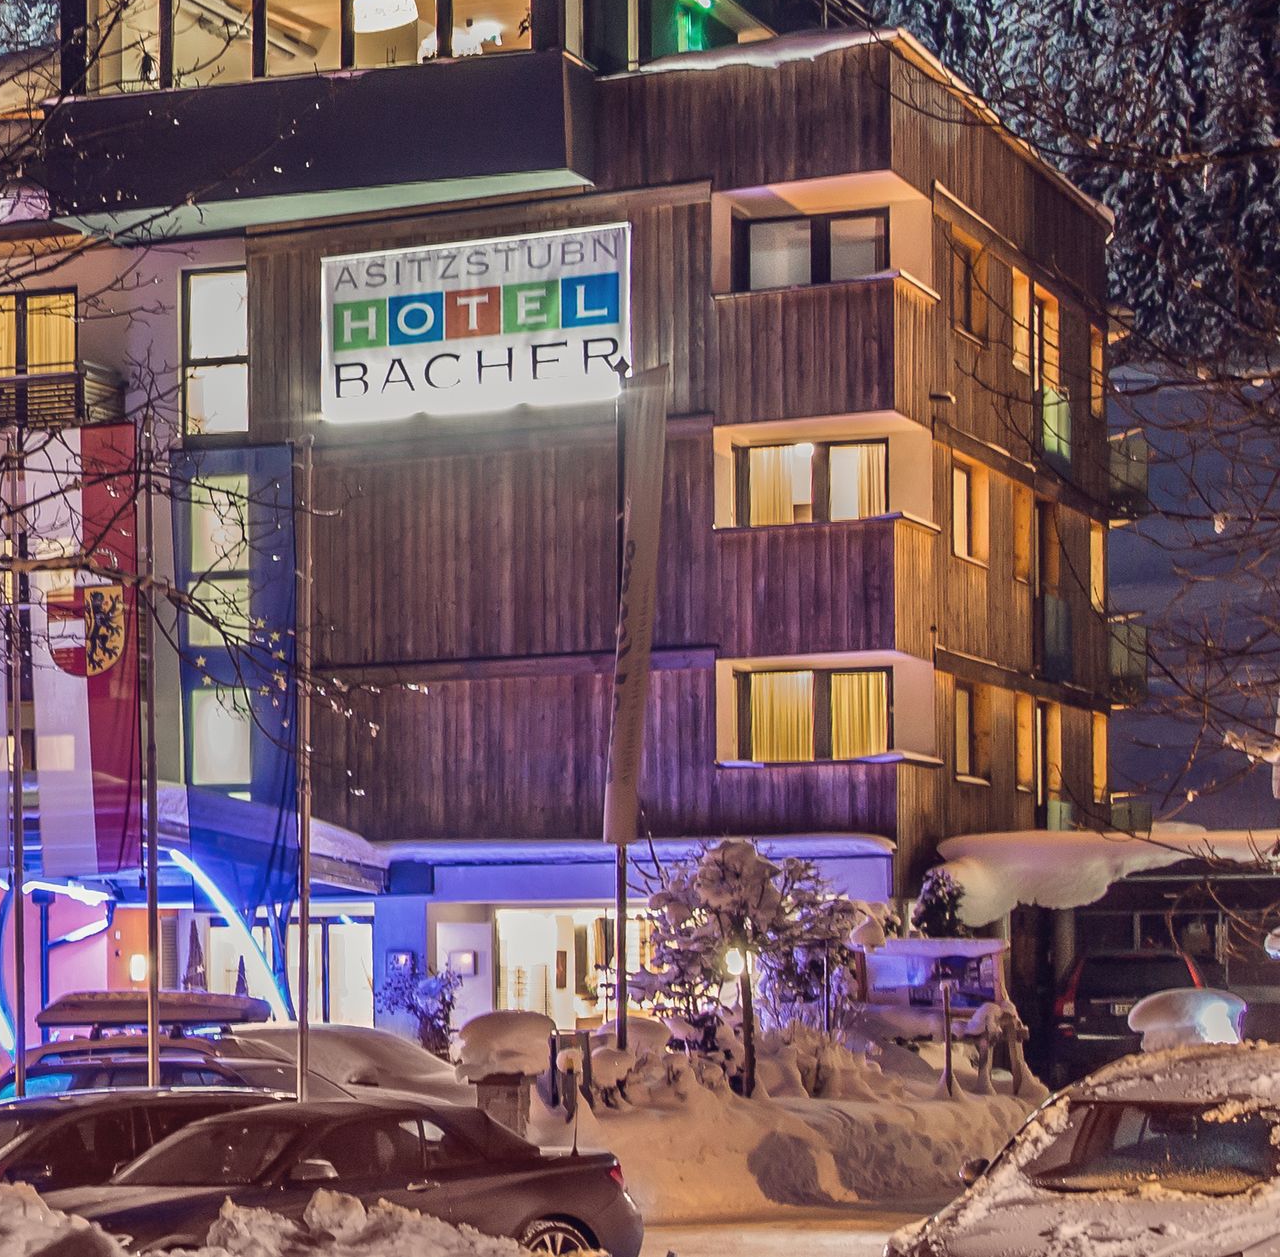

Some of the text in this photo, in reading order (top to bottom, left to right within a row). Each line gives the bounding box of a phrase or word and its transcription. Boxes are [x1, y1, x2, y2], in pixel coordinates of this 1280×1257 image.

[334, 235, 619, 292] ASITZSTUBN
[341, 284, 609, 344] HOTEL
[334, 336, 622, 399] BACHER
